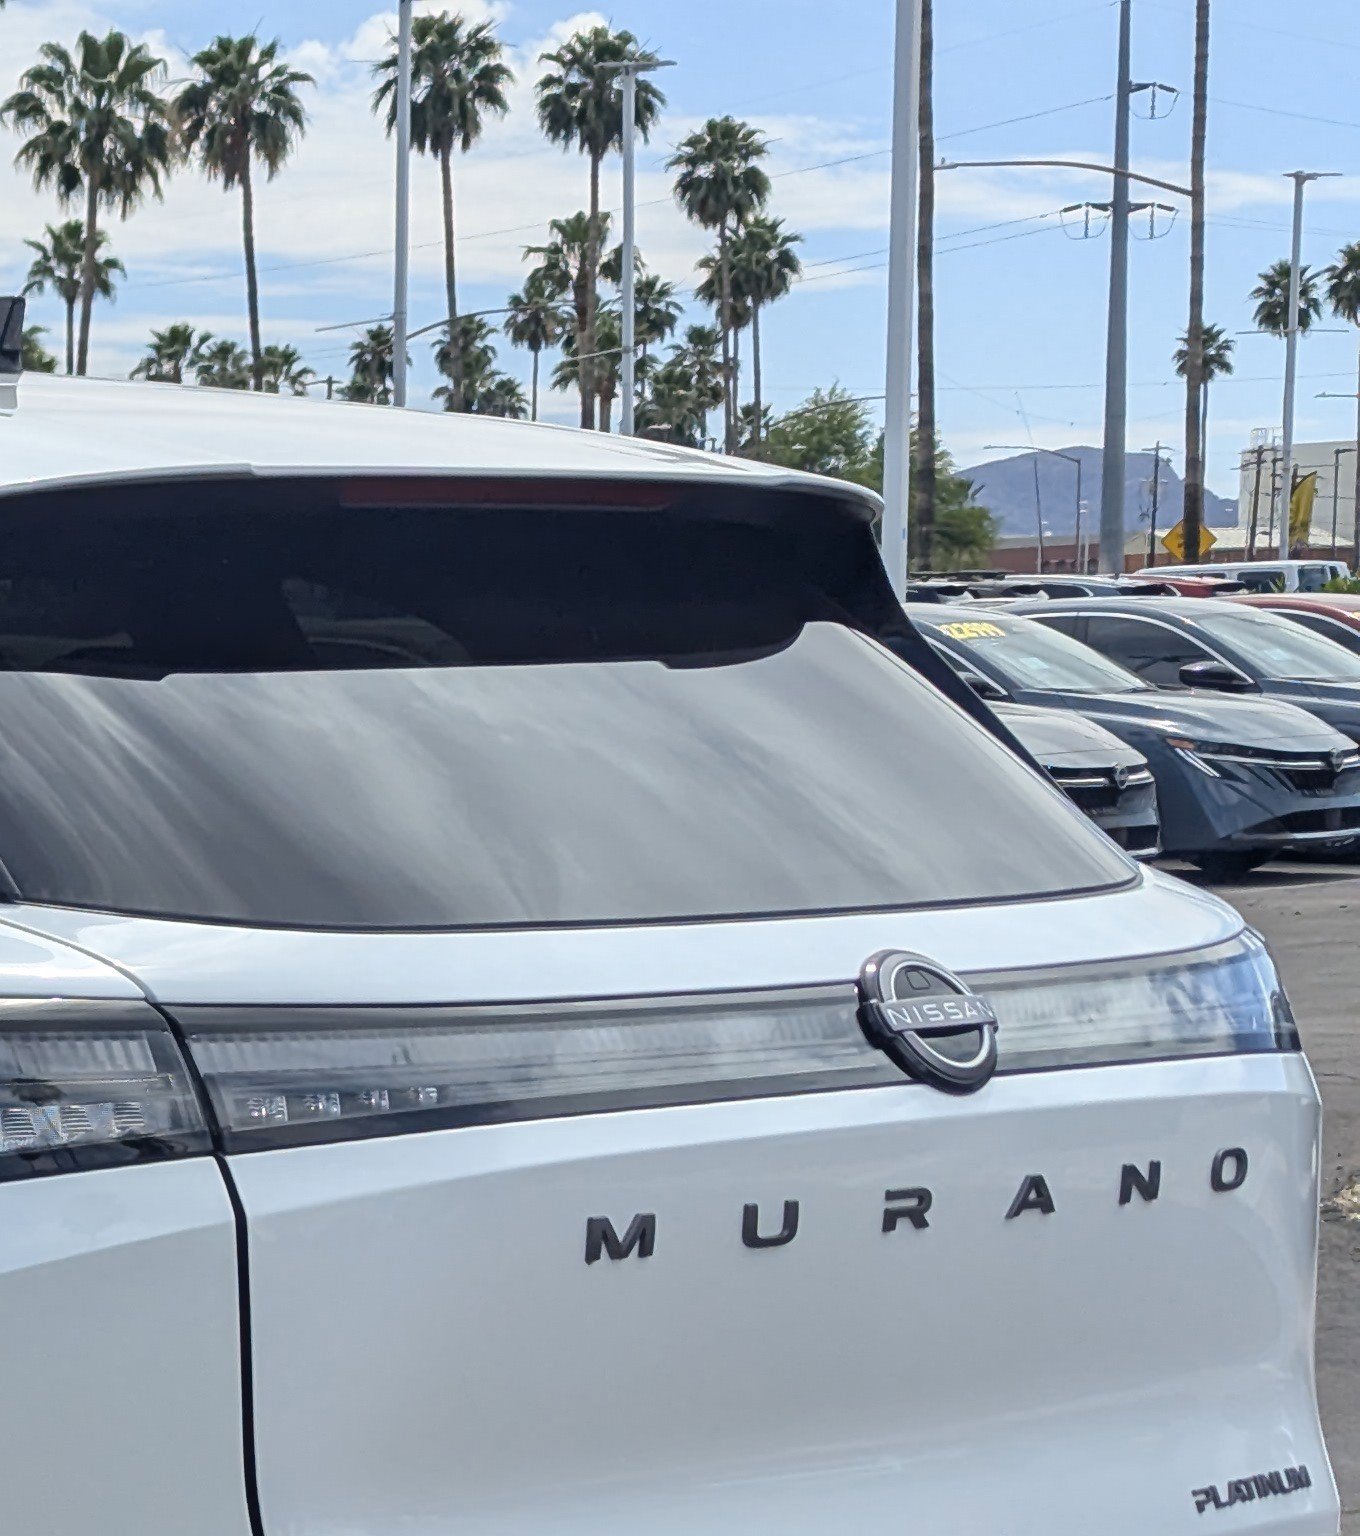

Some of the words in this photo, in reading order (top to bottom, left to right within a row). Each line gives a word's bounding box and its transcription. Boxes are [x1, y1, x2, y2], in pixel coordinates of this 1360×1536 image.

[886, 1001, 995, 1027] NISSAN
[583, 1146, 1249, 1265] MURANO
[1191, 1464, 1312, 1514] PLATINUM
